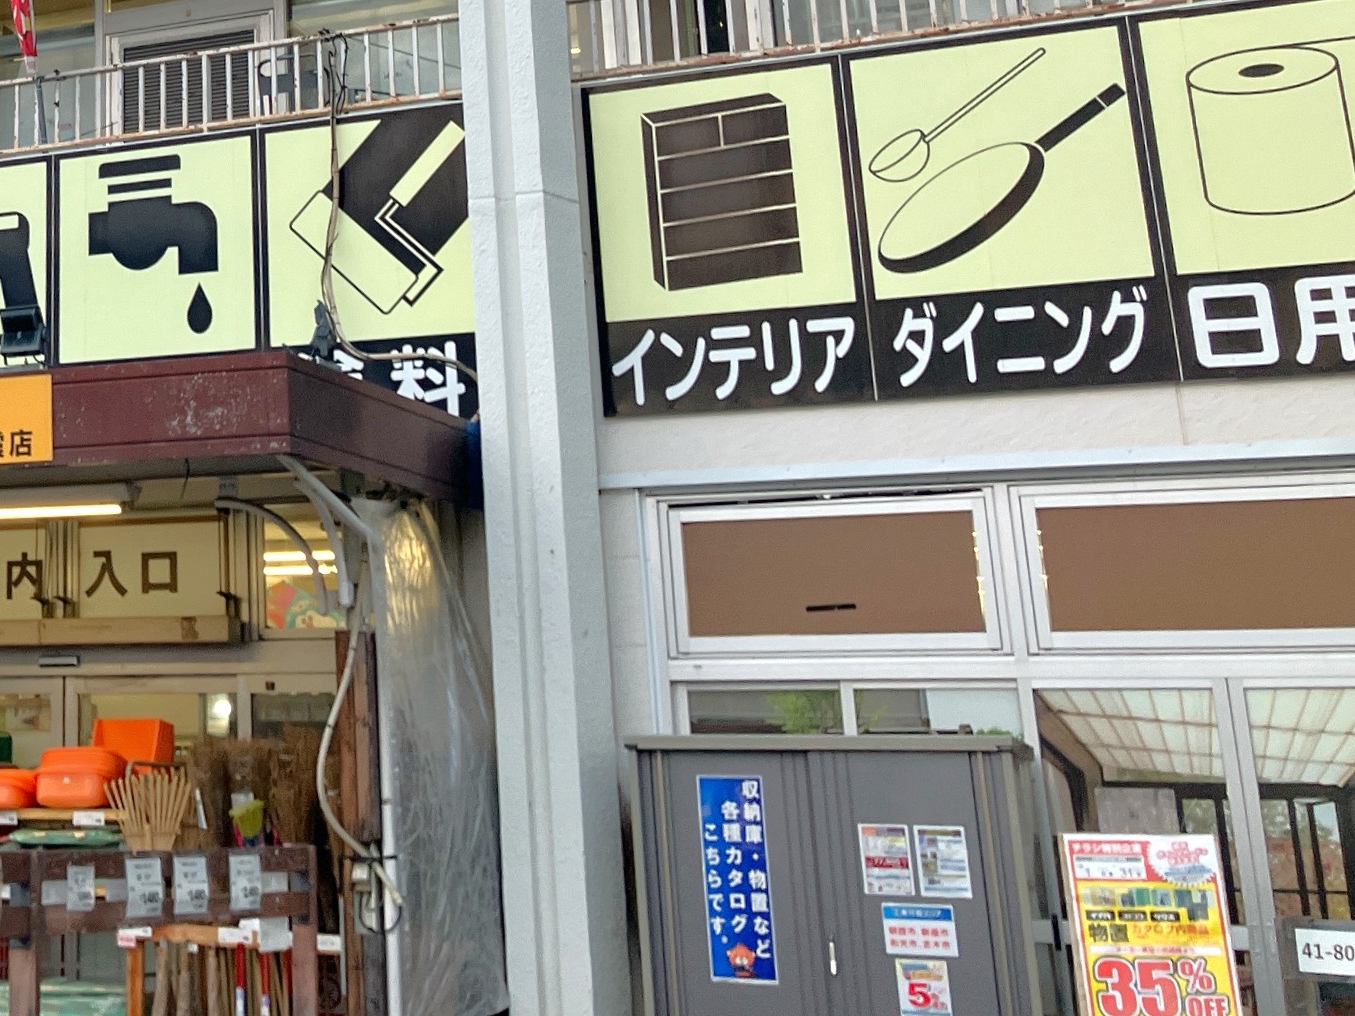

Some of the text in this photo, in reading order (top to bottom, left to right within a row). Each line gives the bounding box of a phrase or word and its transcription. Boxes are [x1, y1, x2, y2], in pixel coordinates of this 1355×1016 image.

[612, 317, 855, 406] インテリア
[894, 285, 1147, 387] ダイニング
[1187, 273, 1355, 368] 日用
[704, 824, 729, 945] こちらです。
[721, 801, 748, 933] 各種カタログ
[742, 780, 772, 959] 収納庫・物置など
